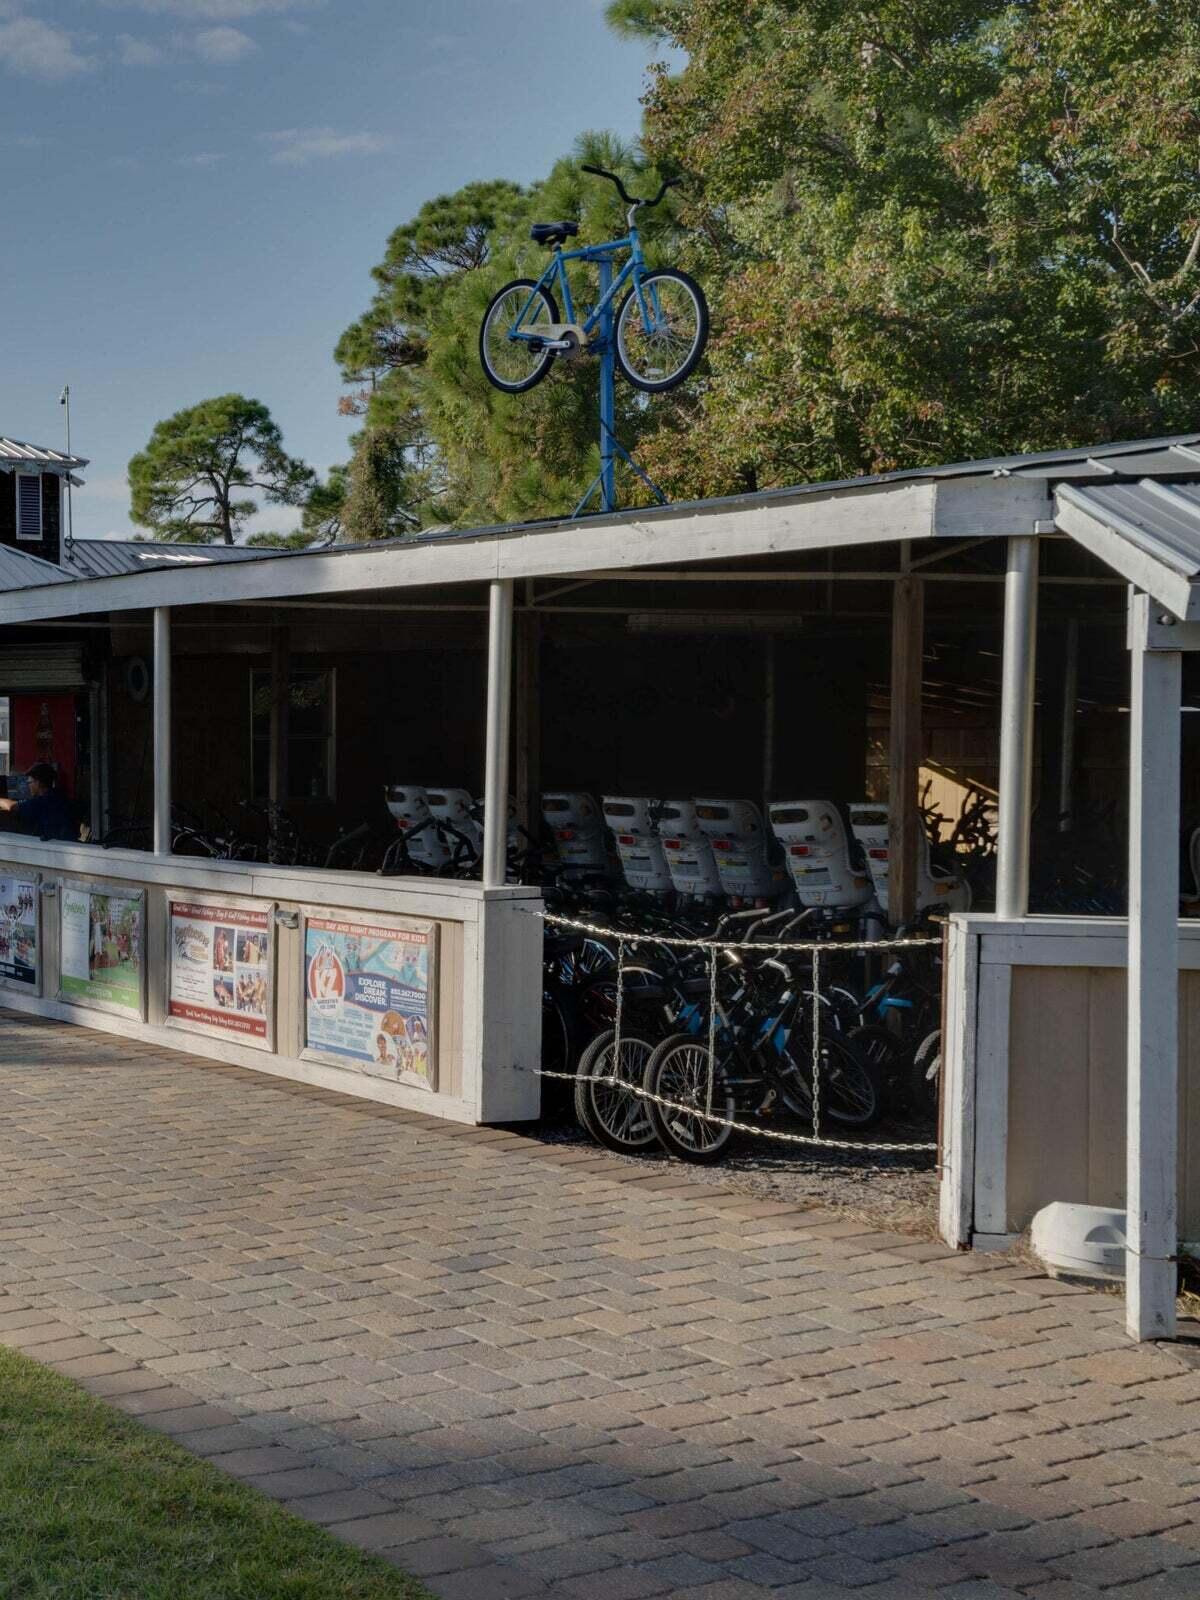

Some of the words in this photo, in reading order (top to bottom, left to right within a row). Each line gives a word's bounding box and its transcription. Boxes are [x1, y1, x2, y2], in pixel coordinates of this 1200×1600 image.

[325, 922, 338, 931] DAY
[338, 924, 350, 932] AND
[351, 925, 368, 935] NIGHT
[369, 928, 397, 939] PROGRAM
[398, 931, 411, 941] FOR
[411, 933, 427, 943] KIDS
